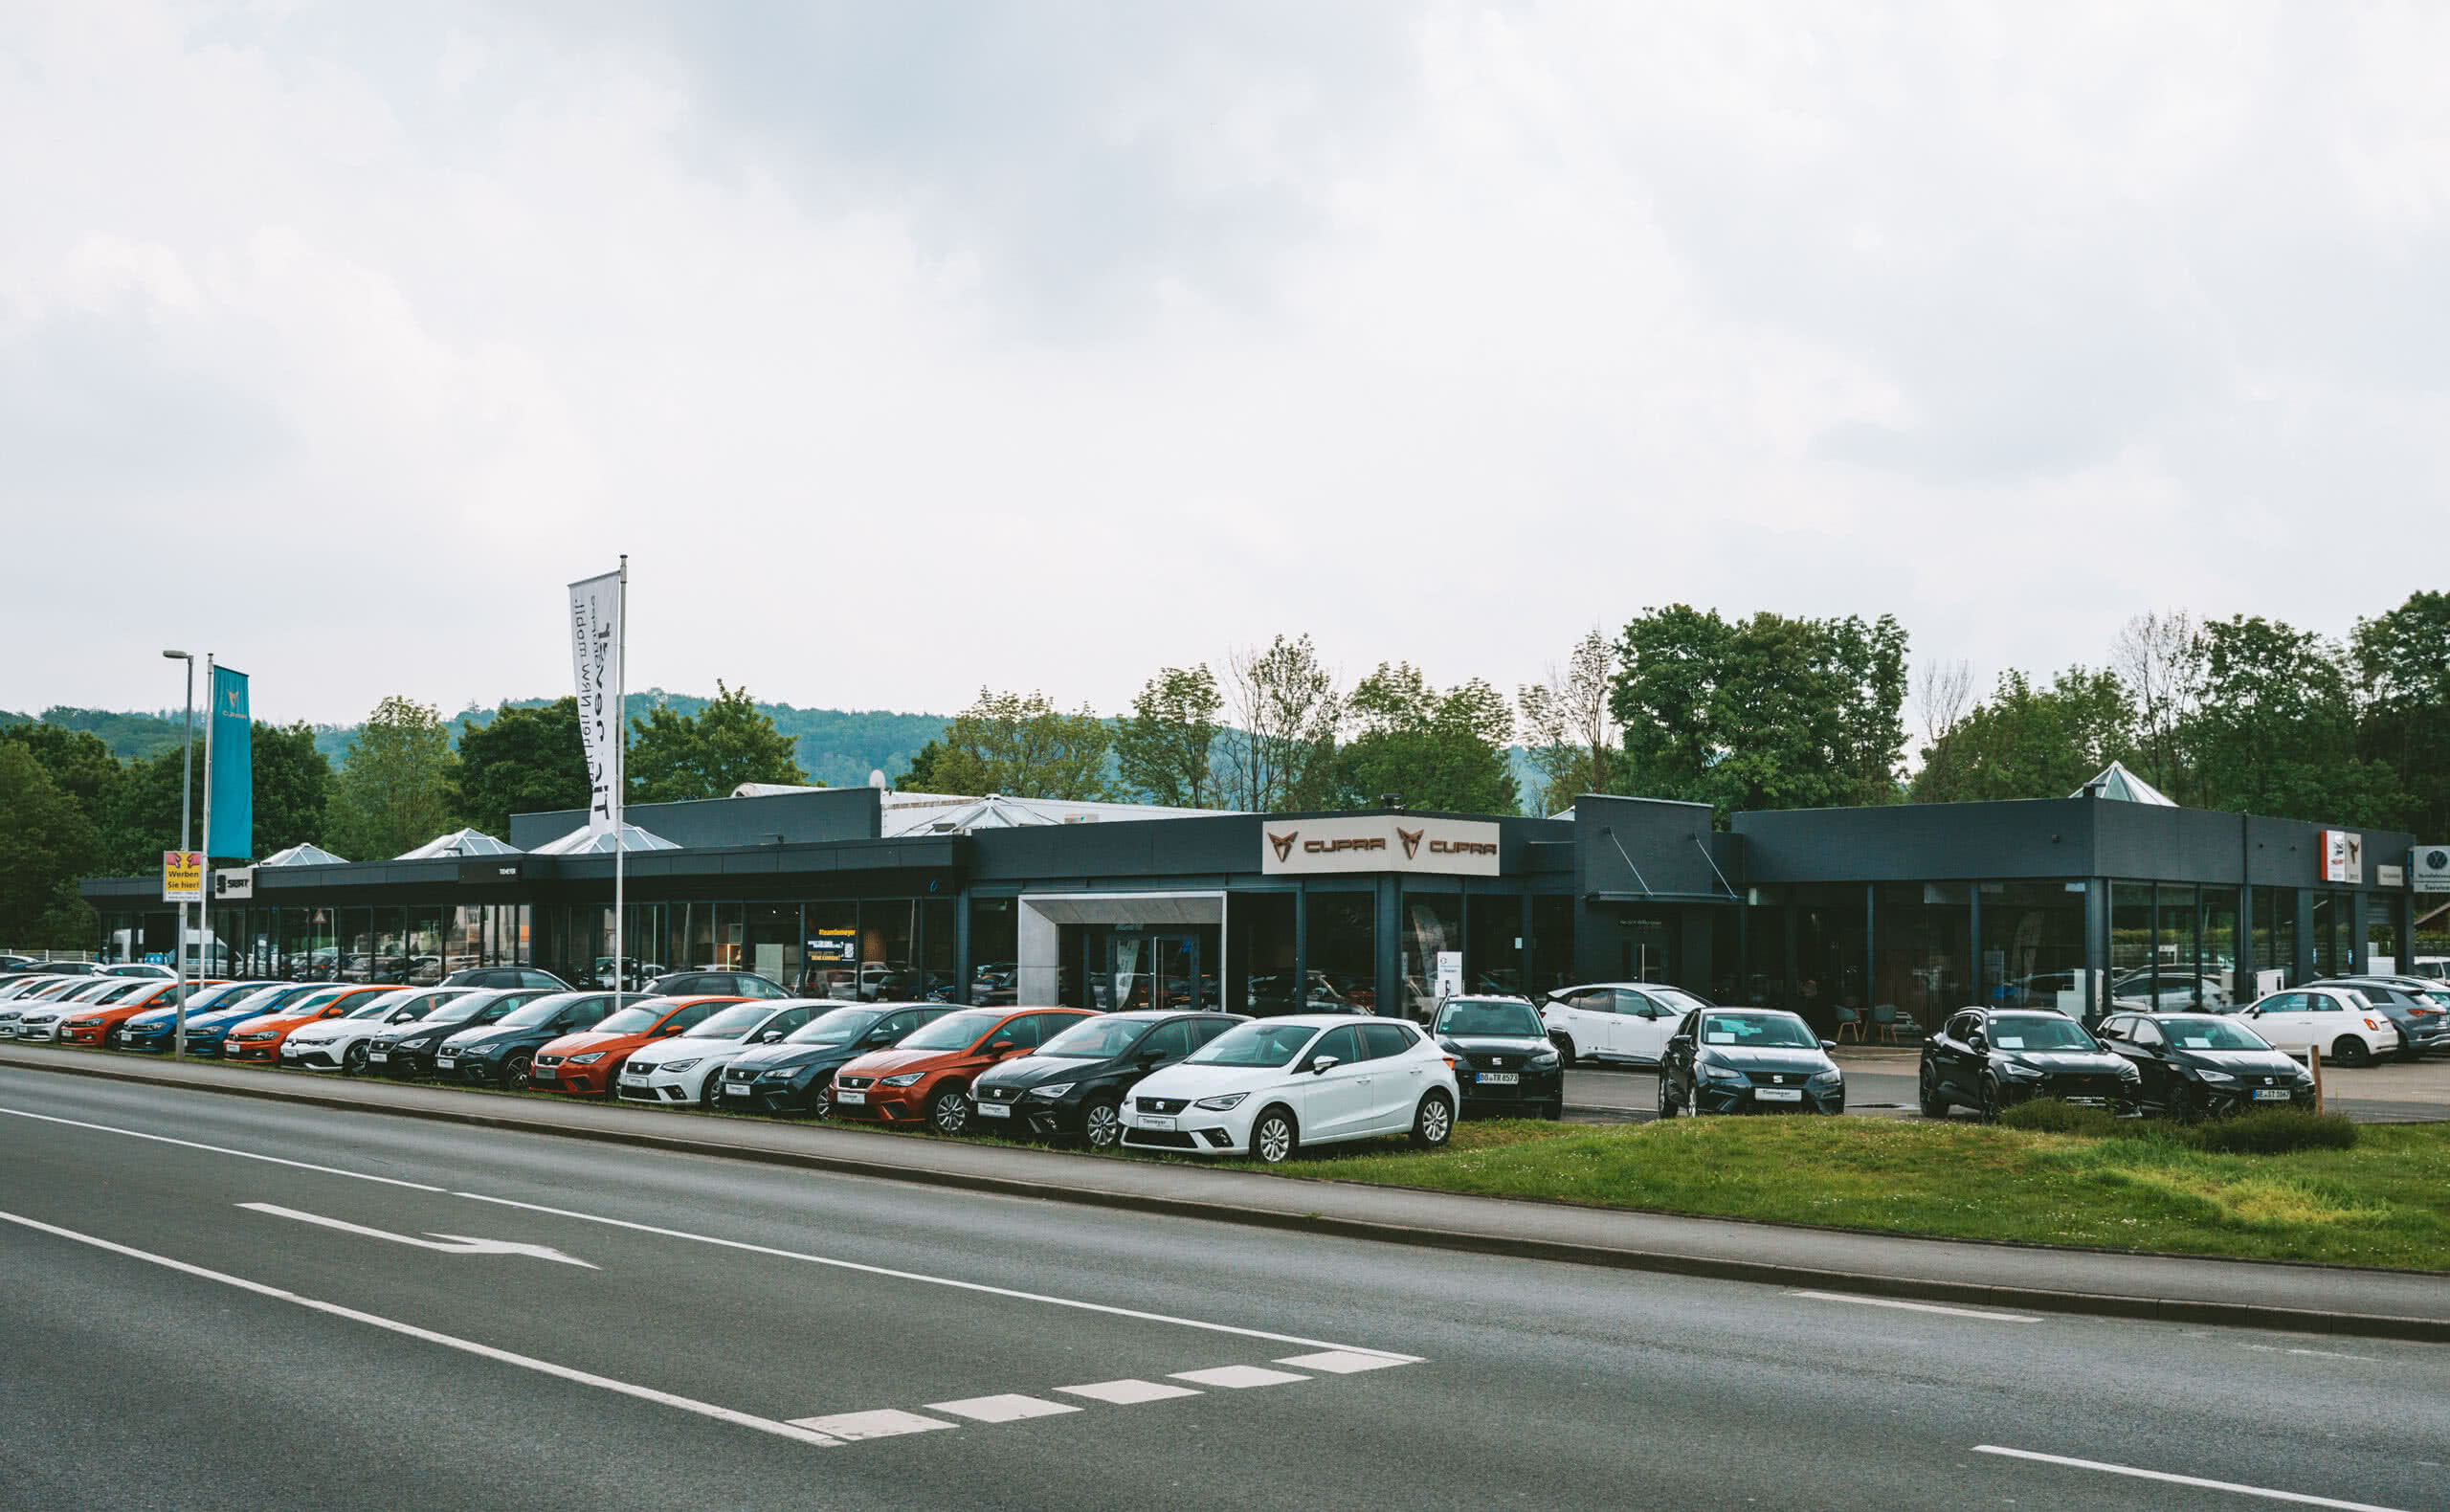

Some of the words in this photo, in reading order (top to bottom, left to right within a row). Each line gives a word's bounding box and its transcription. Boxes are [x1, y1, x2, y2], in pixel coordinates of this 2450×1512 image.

[1303, 837, 1386, 853] CUPRA
[1430, 840, 1497, 855] CUPRA
[227, 878, 249, 888] SEAT
